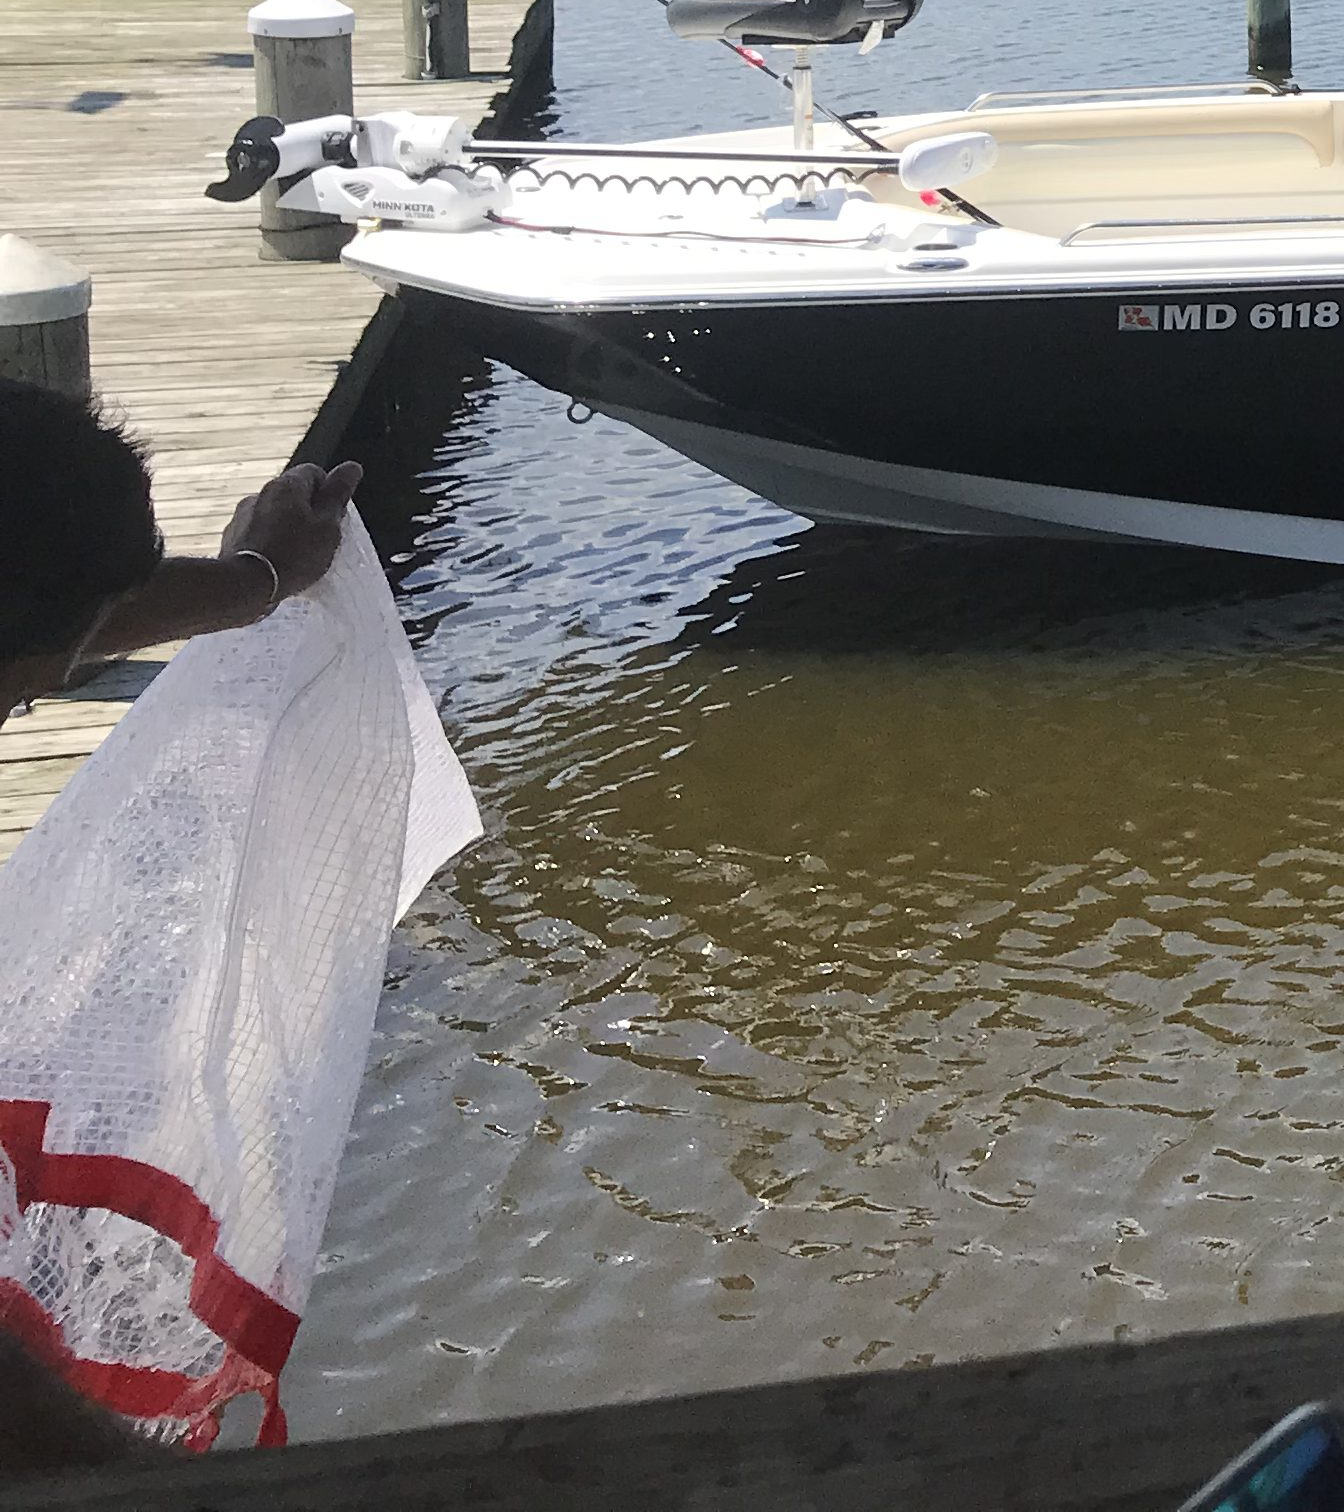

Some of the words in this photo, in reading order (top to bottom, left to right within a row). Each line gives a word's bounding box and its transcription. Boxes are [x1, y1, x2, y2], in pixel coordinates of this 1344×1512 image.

[372, 200, 401, 211] MINN
[404, 202, 435, 213] KOTA
[1162, 304, 1237, 331] MD
[1250, 301, 1340, 330] 6118
